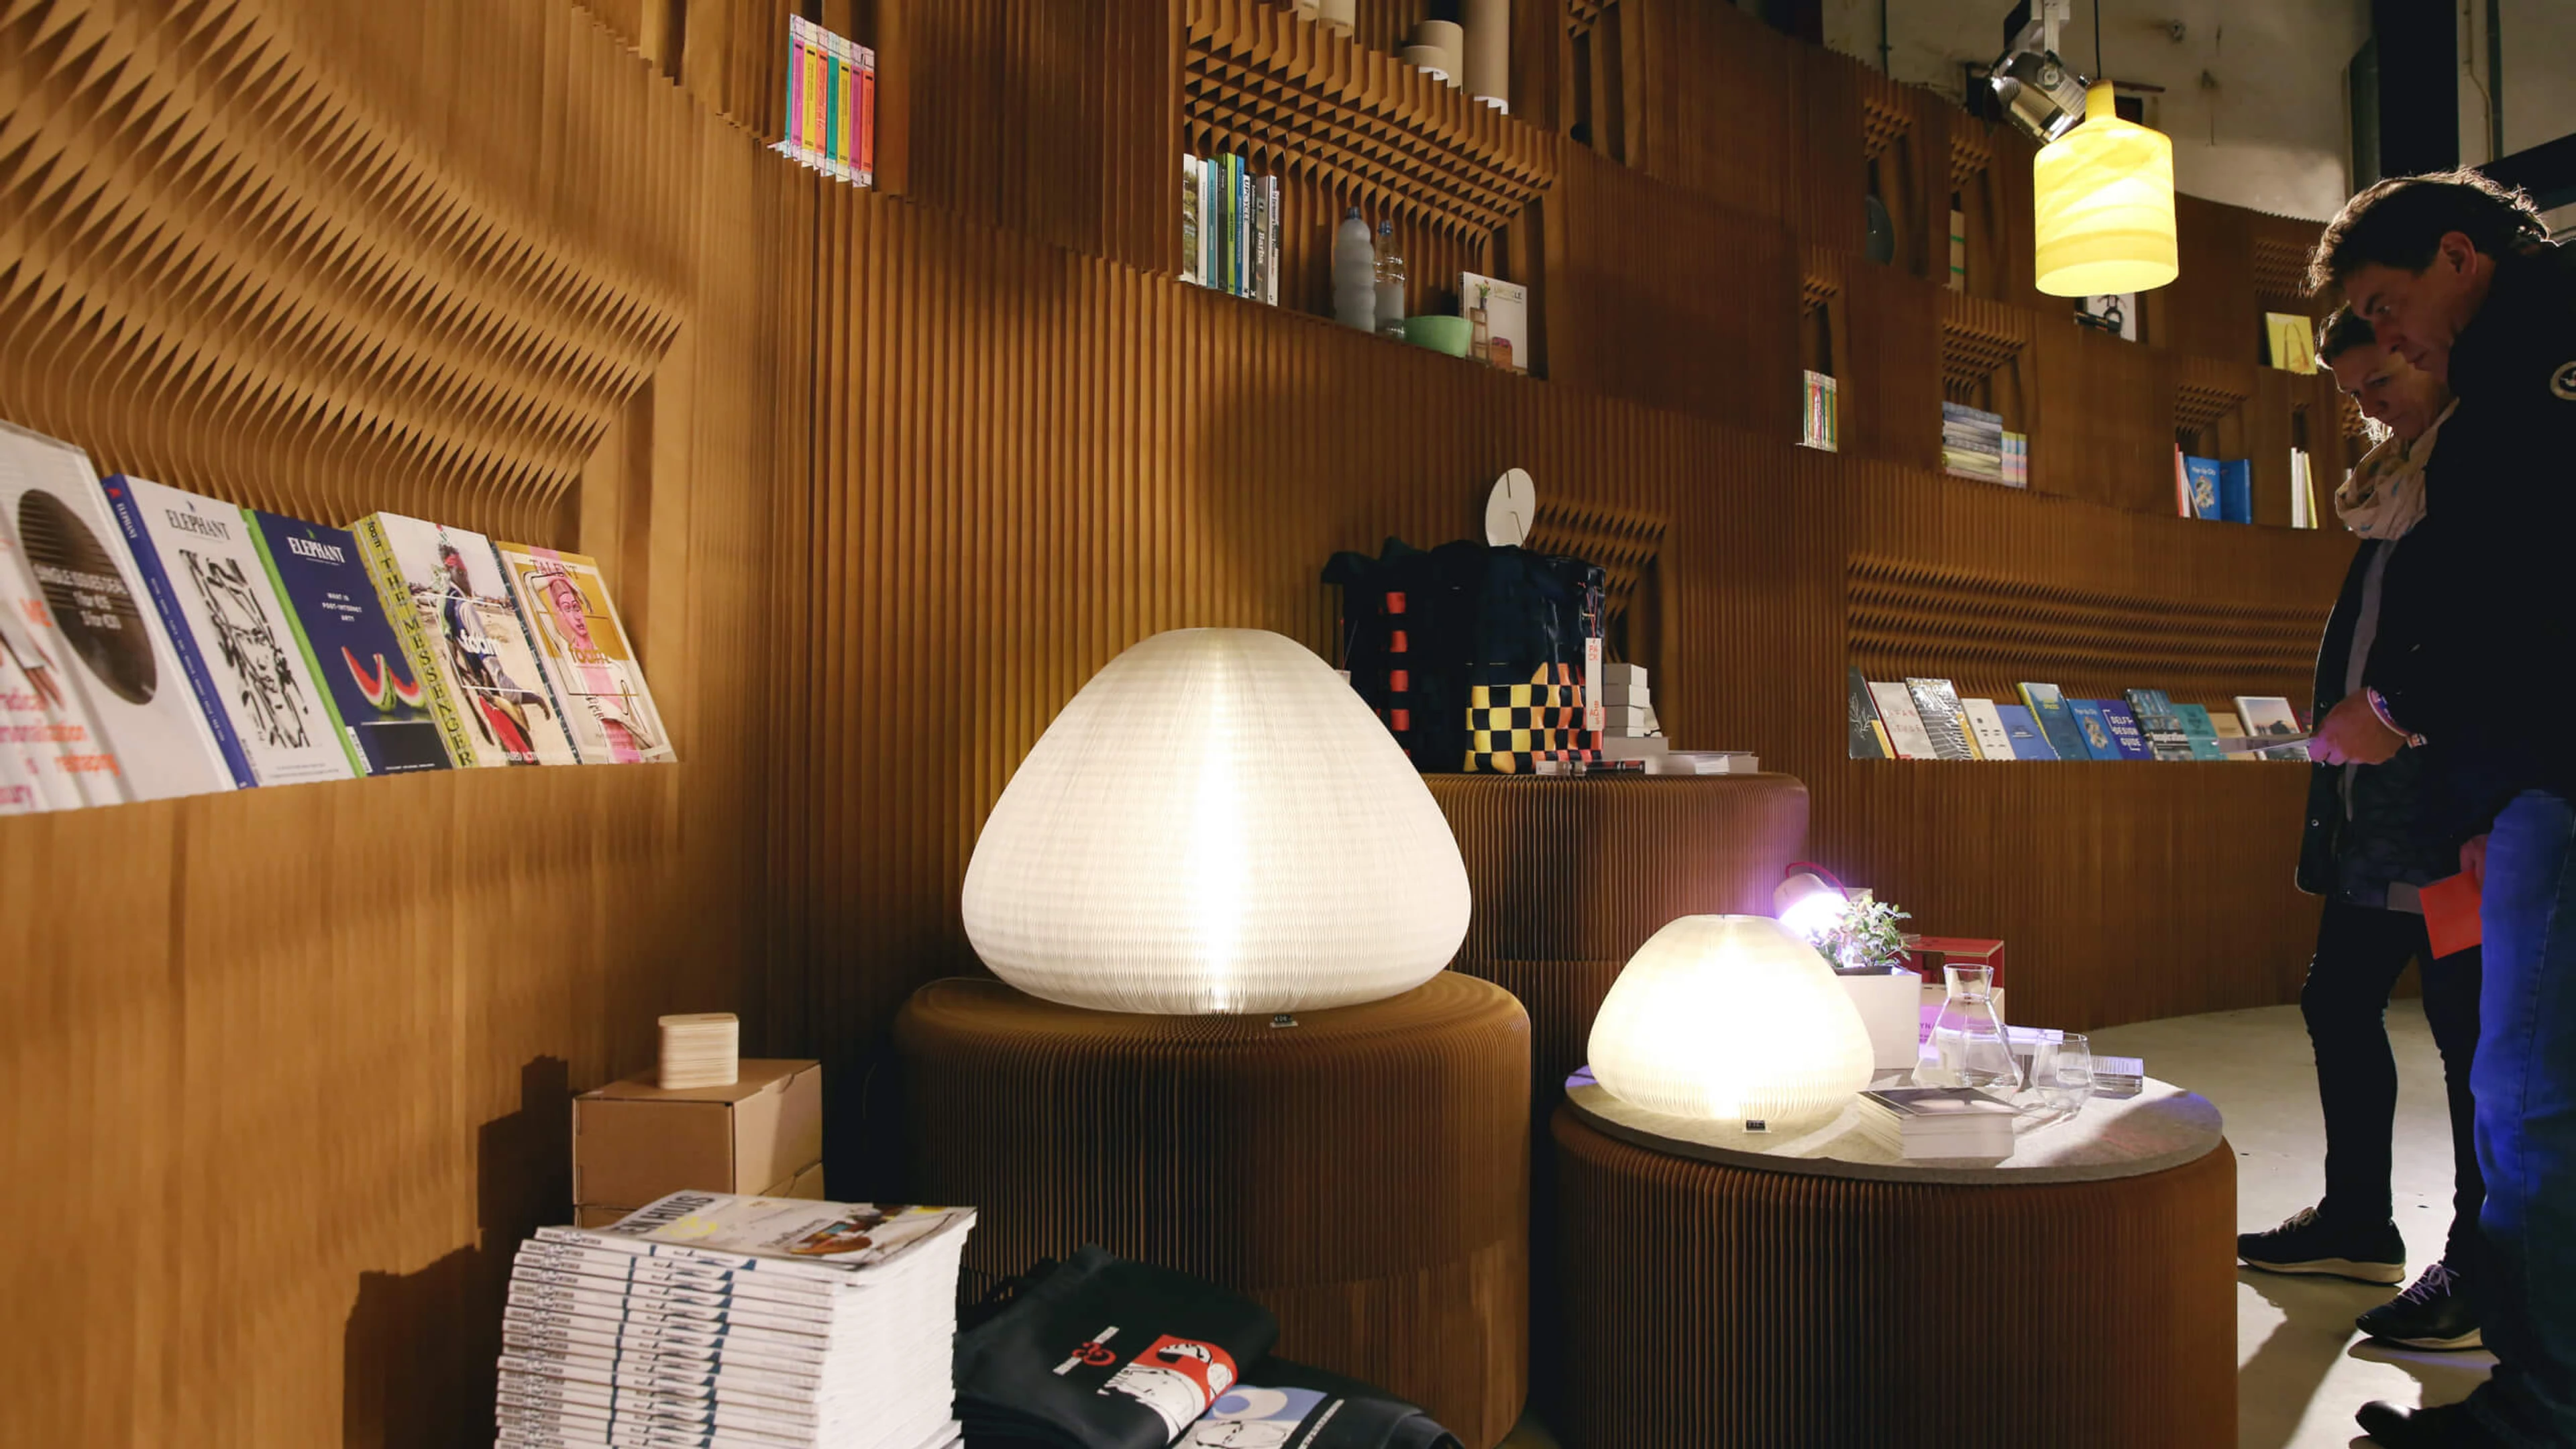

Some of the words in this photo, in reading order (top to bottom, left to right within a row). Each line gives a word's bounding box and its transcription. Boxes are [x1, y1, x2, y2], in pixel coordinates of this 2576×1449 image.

[117, 503, 138, 539] ELEPHANT
[166, 509, 231, 540] ELEPHANT
[368, 521, 382, 548] foam
[286, 536, 345, 564] ELEPHANT
[404, 615, 473, 767] MESSENGER
